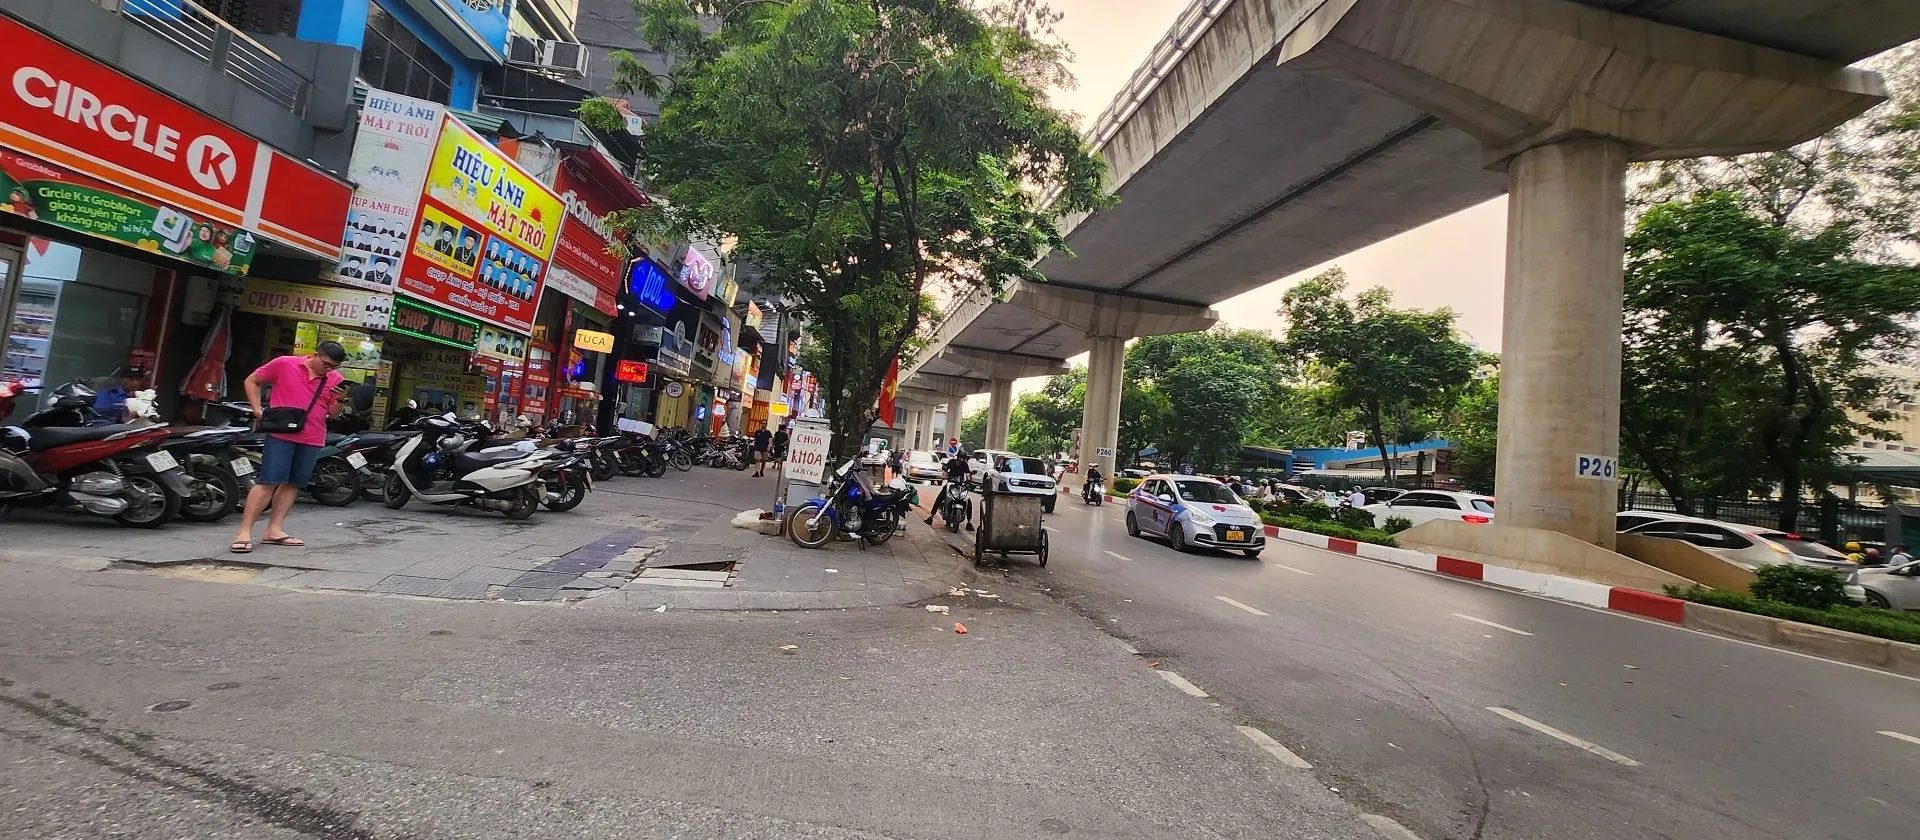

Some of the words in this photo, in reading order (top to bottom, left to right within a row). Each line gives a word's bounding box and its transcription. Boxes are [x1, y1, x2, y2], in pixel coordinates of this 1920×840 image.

[369, 97, 402, 114] HIỆU
[404, 101, 435, 121] ẢNH
[13, 67, 180, 163] CIRCLE
[198, 144, 231, 187] K
[397, 121, 430, 139] TRỜI
[452, 145, 493, 187] HIỆU
[493, 167, 525, 209] ẢNH
[39, 187, 72, 200] Circle
[74, 192, 81, 201] K
[83, 194, 91, 202] x
[92, 195, 142, 217] GrabMart
[49, 200, 75, 211] giao
[77, 204, 109, 219] xuyên
[56, 211, 92, 228] không
[486, 200, 517, 233] MẶT
[518, 219, 546, 251] TRỜI
[427, 266, 447, 282] CHỤP
[447, 272, 461, 289] ẢNH
[461, 280, 474, 293] THẺ
[248, 291, 289, 312] CHỤP
[291, 290, 327, 315] ẢNH
[330, 298, 360, 319] THẺ
[577, 333, 605, 346] TUCA
[1096, 448, 1112, 456] P260
[1579, 456, 1616, 478] P261
